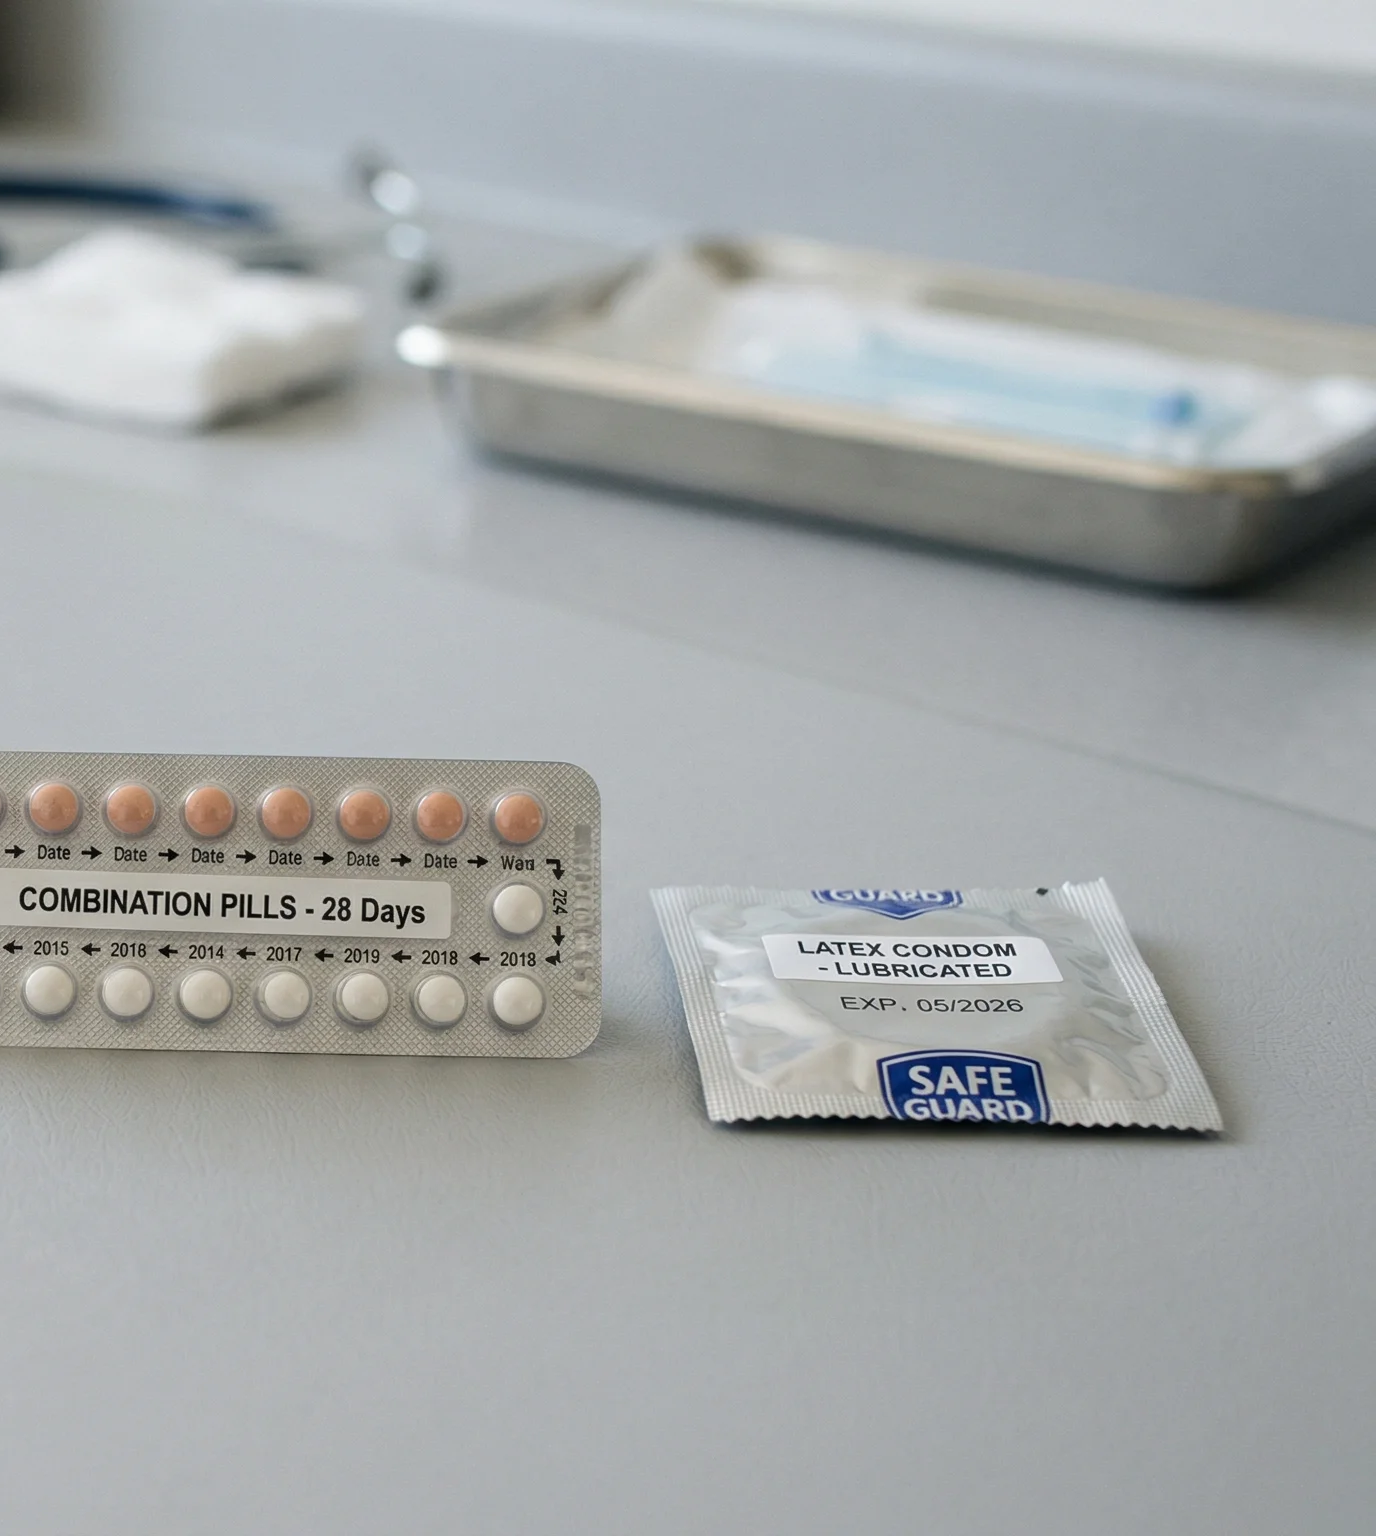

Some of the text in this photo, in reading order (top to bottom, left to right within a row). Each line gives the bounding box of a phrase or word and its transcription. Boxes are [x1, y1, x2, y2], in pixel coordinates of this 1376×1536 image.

[37, 844, 71, 861] Date
[114, 846, 148, 863] Date
[191, 847, 225, 864] Date
[268, 849, 303, 866] Date
[346, 850, 380, 867] Date
[423, 852, 458, 869] Date
[19, 886, 211, 917] COMBINATION
[221, 893, 297, 920] PILLS
[321, 896, 352, 922] 28
[361, 897, 426, 930] Days
[33, 940, 69, 956] 2015
[188, 944, 225, 960] 2014
[266, 946, 303, 962] 2017
[343, 947, 380, 964] 2019
[421, 949, 458, 966] 2018
[500, 951, 537, 967] 2018
[797, 940, 1017, 958] LATEX CONDOM
[834, 961, 1012, 978] LUBRICATED
[840, 996, 1024, 1013] EXP. 05/2026
[908, 1065, 1017, 1096] SAFE
[902, 1099, 1035, 1122] GUARD
